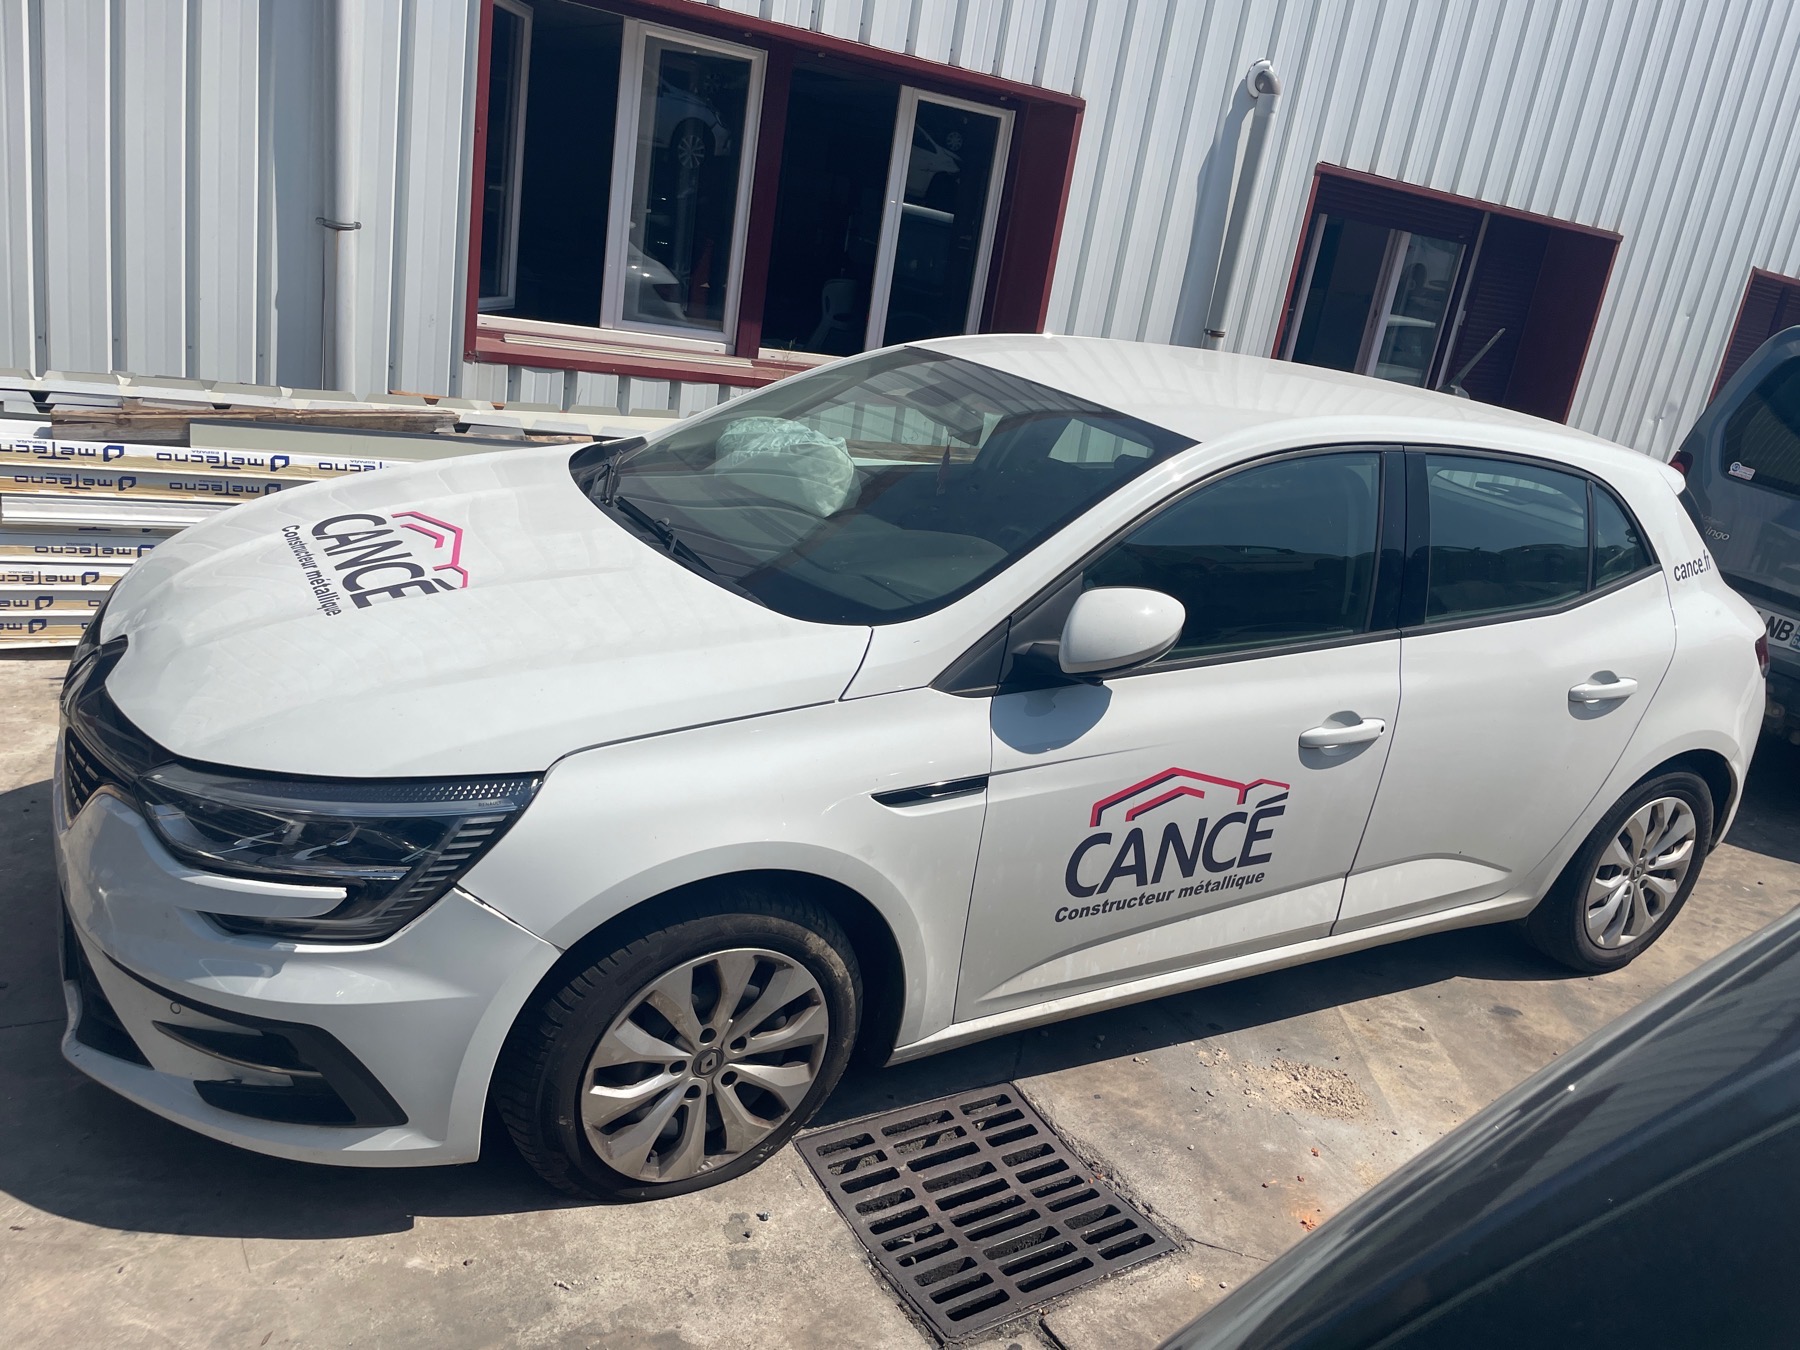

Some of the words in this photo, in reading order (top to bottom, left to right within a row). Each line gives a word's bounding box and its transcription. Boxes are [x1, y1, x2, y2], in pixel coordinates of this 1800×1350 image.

[0, 441, 97, 461] meTecn
[281, 524, 318, 575] Constructeur
[304, 567, 343, 617] métallique
[311, 513, 458, 610] CANCÉ
[1673, 549, 1711, 582] cance.fr
[1064, 791, 1289, 898] CANCÉ
[1054, 887, 1175, 923] Constructeur
[1177, 871, 1265, 899] métallique
